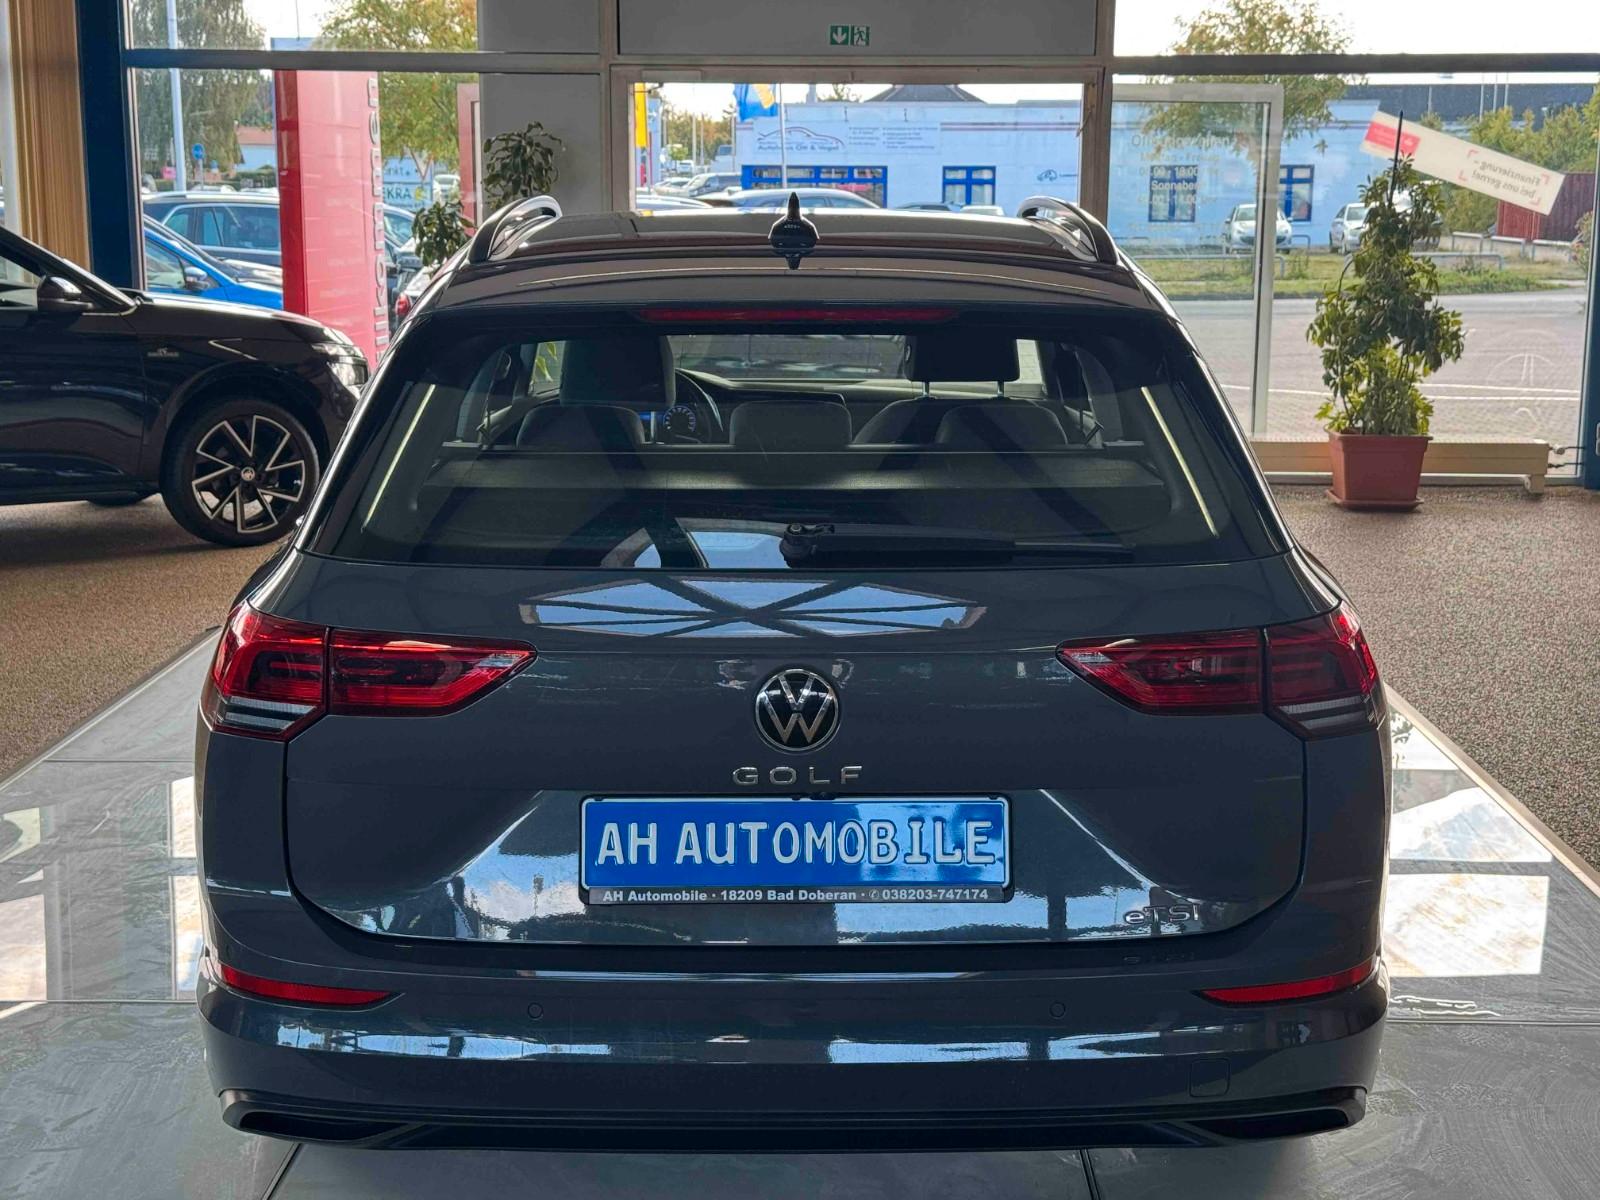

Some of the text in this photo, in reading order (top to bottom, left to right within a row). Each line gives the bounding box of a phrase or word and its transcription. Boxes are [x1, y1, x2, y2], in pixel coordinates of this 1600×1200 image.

[733, 765, 863, 785] GOLF
[597, 819, 995, 865] AH AUTOMOBILE
[603, 889, 989, 902] AH Automobile 18209 Bad Doberan 038203-747174
[1123, 904, 1199, 924] eTSI
